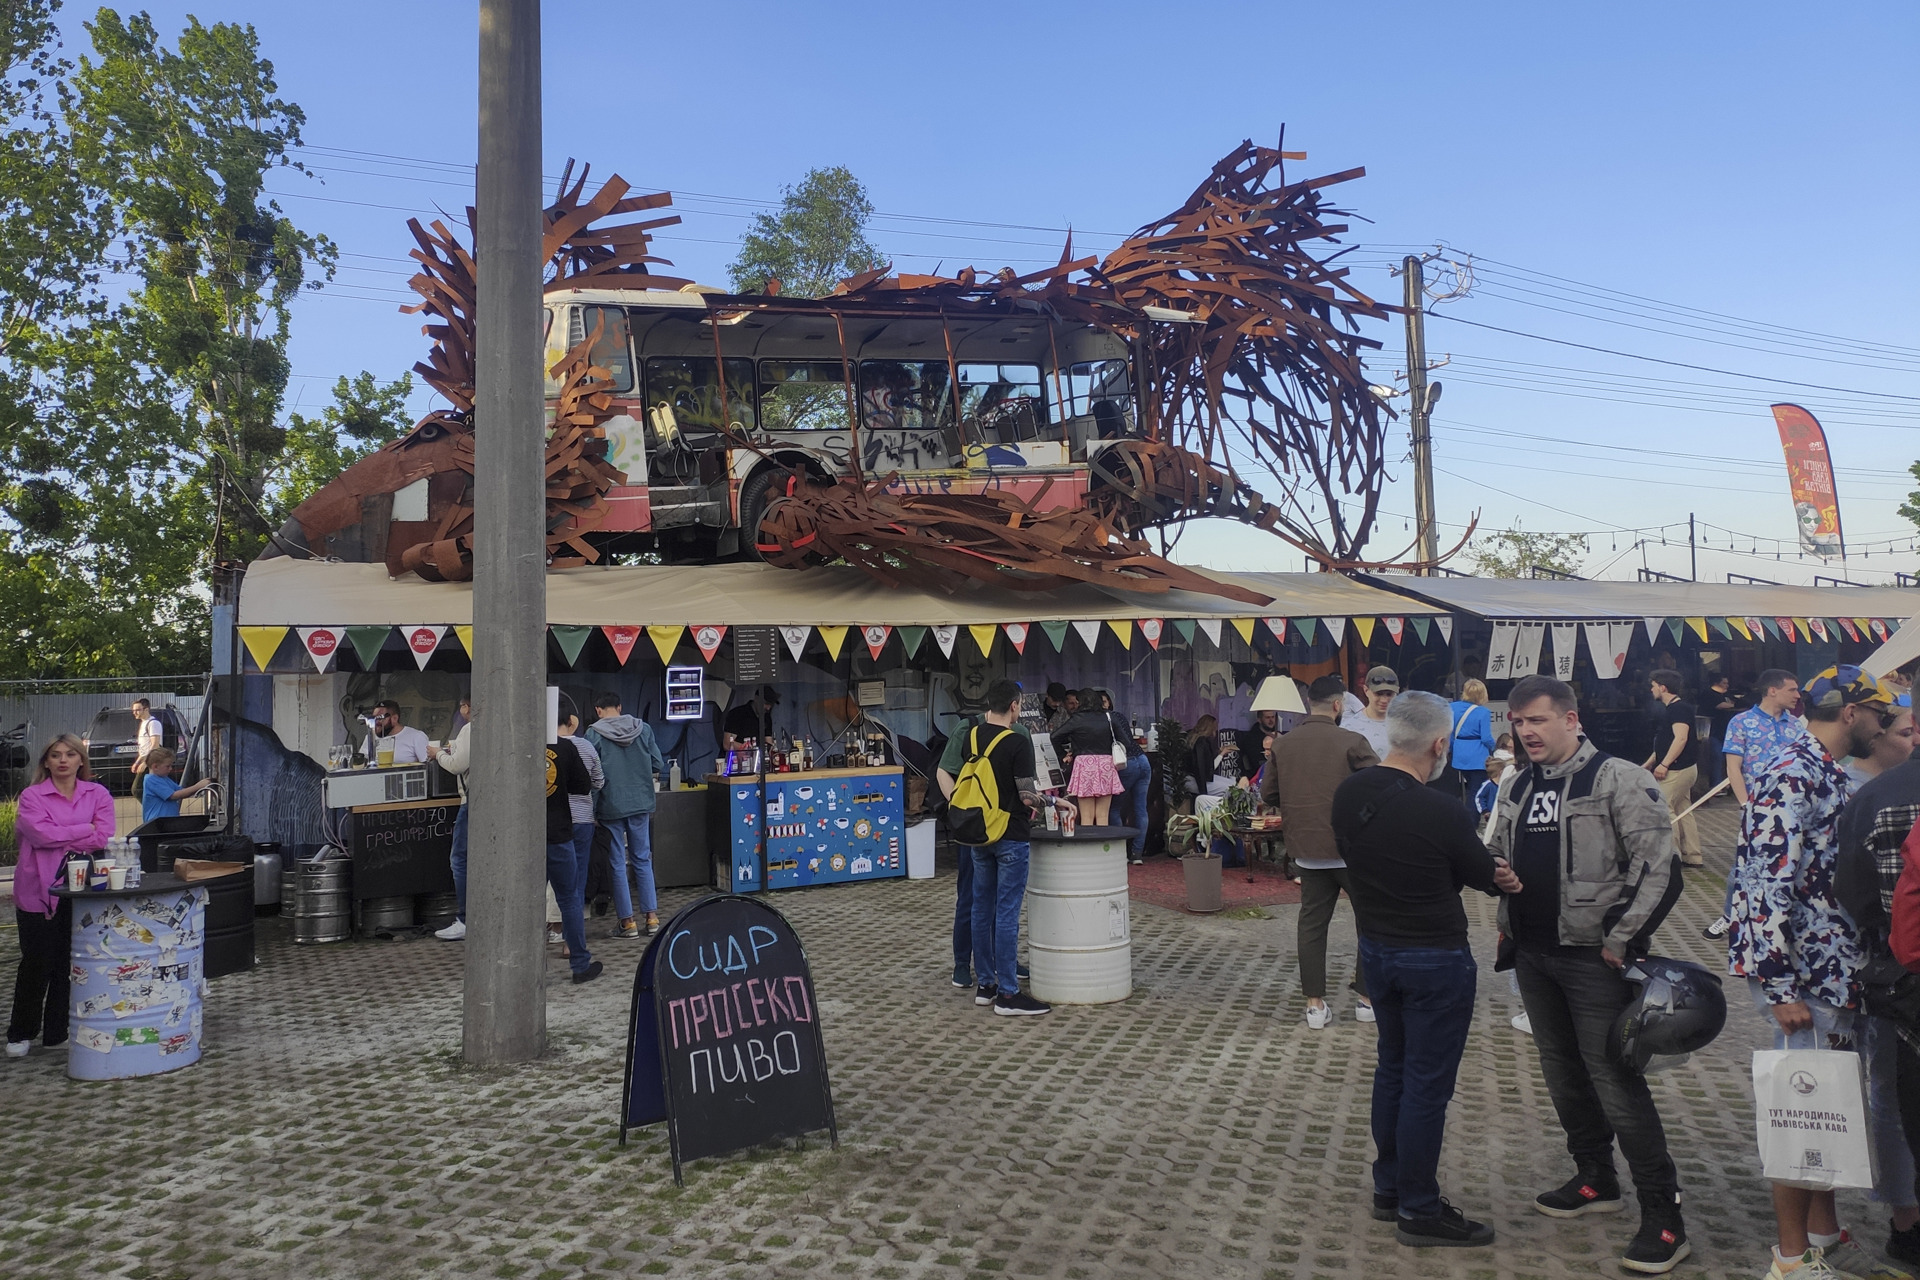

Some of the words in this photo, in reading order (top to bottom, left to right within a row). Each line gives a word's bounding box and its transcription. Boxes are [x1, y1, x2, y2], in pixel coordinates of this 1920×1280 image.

[668, 976, 812, 1049] ПРОСЕКО
[689, 1030, 802, 1094] ПИВО
[1768, 1108, 1784, 1117] ТУТ
[1786, 1110, 1848, 1123] НАРОДИЛАСЬ
[1770, 1119, 1822, 1131] ЛЬВІВСЬКА
[1825, 1122, 1848, 1134] КАВА
